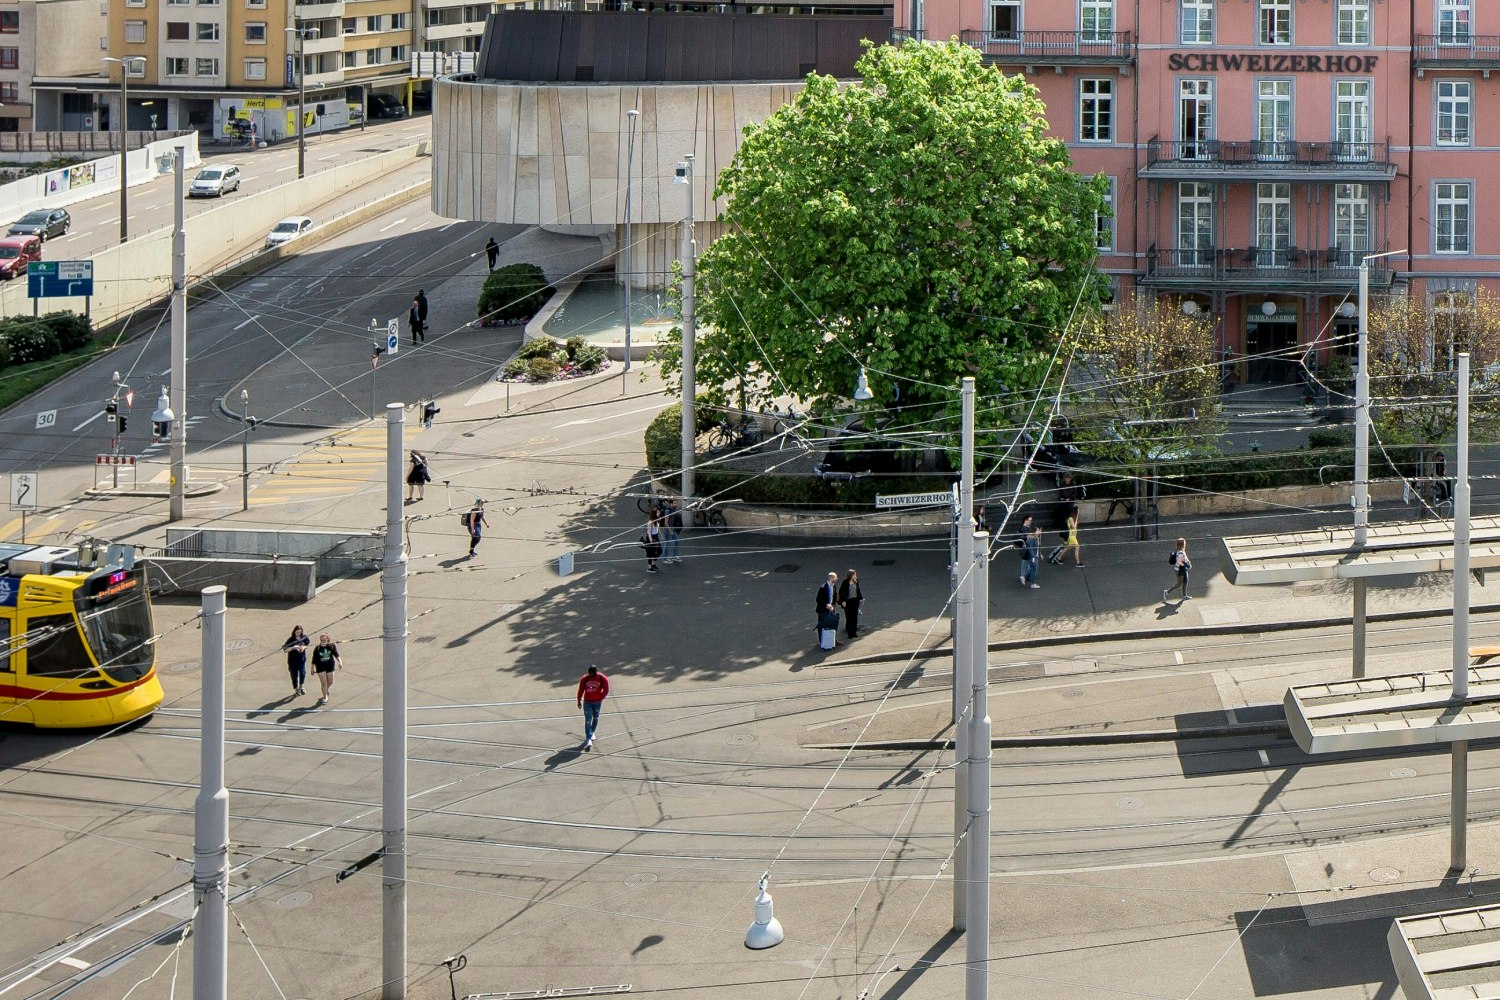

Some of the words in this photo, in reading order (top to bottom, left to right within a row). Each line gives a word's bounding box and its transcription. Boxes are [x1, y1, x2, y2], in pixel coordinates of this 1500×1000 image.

[1168, 53, 1379, 73] SCHWEIZERHOF
[38, 413, 54, 426] 30
[878, 493, 952, 506] SCHWEIZERHOF
